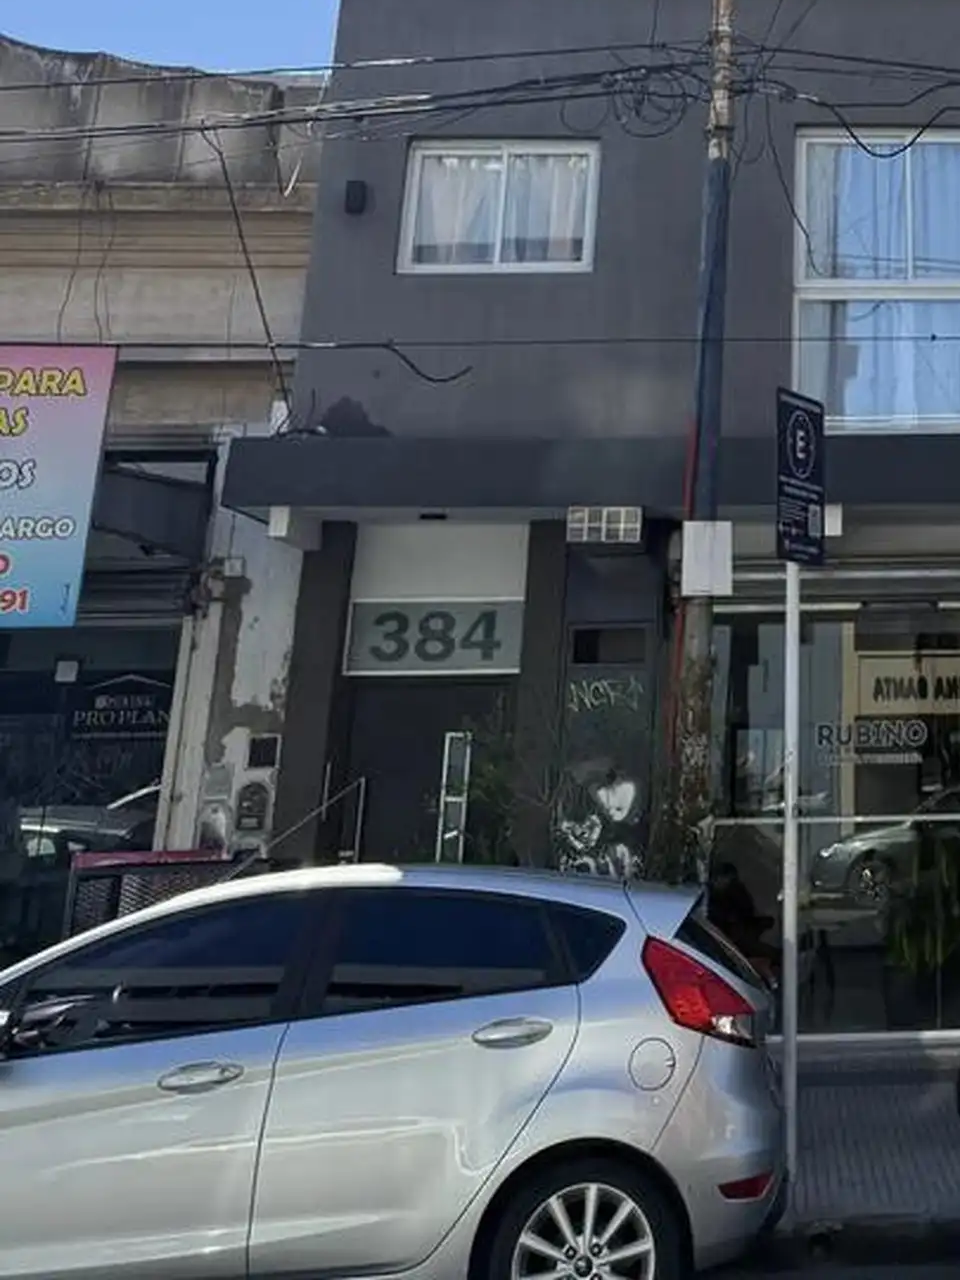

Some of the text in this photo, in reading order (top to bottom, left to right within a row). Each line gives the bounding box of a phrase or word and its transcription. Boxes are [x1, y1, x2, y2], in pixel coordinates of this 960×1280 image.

[0, 517, 75, 539] ARGO
[369, 610, 502, 662] 384
[816, 721, 927, 747] RUBINO
